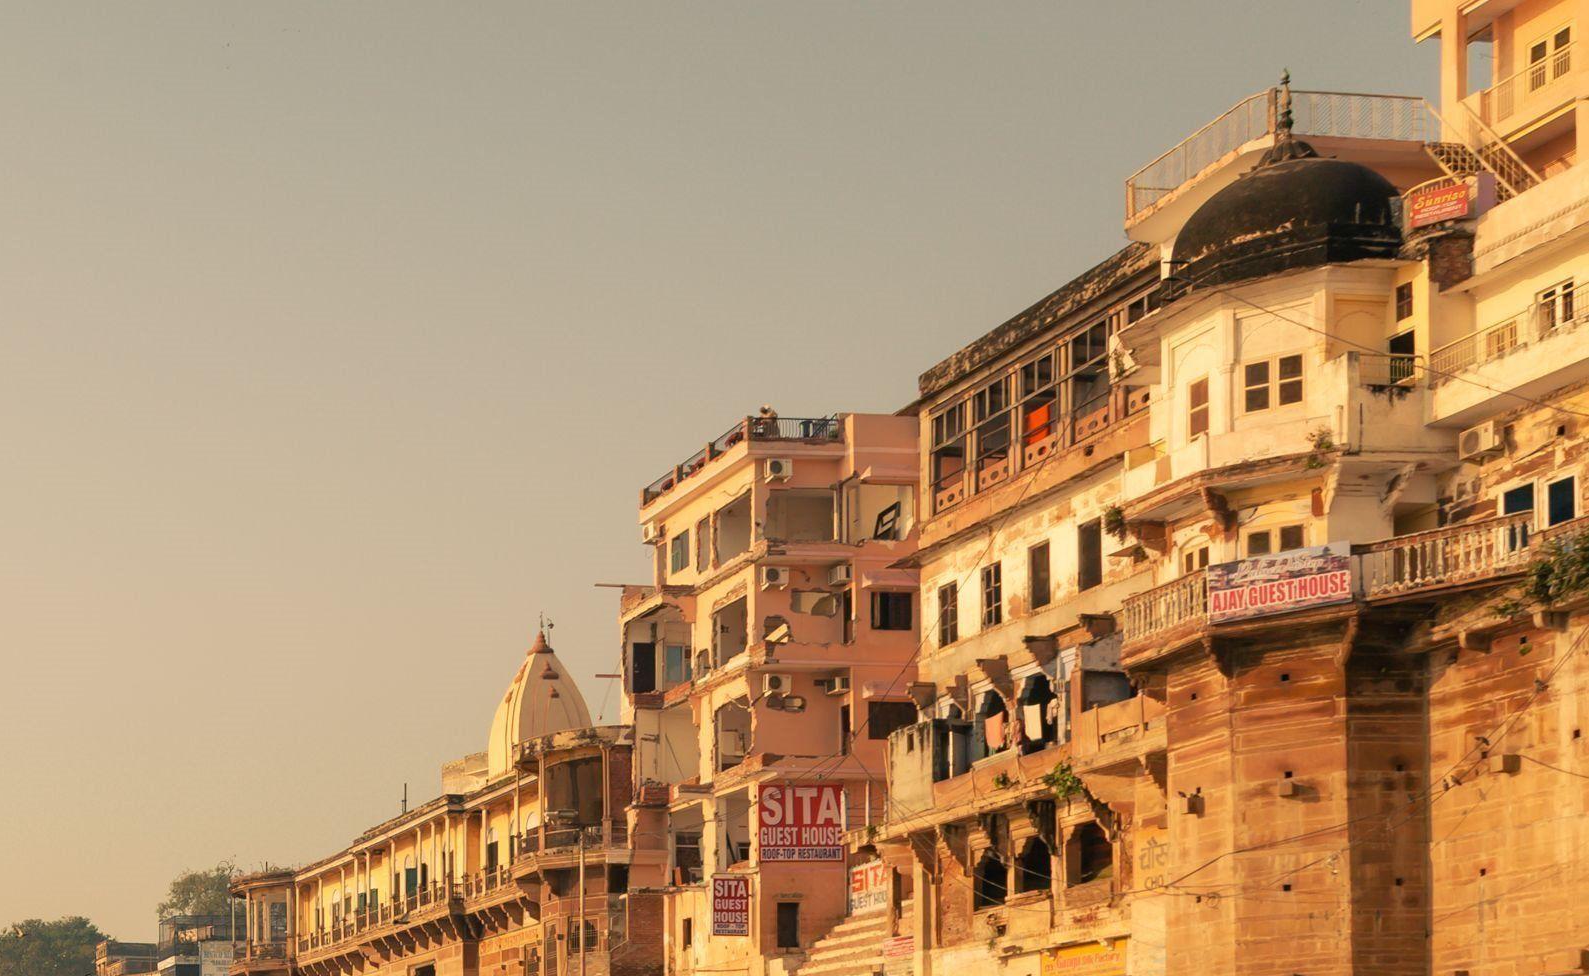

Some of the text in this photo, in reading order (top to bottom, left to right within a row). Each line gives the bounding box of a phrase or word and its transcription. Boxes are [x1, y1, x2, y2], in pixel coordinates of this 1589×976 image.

[1212, 571, 1348, 612] AJAY GUEST HOUSE
[761, 786, 841, 826] SITA
[760, 827, 841, 846] GUEST HOUSE
[798, 848, 841, 859] RESTAURANT
[714, 880, 747, 897] SITA
[714, 899, 747, 910] GUEST
[714, 911, 748, 923] HOUSE
